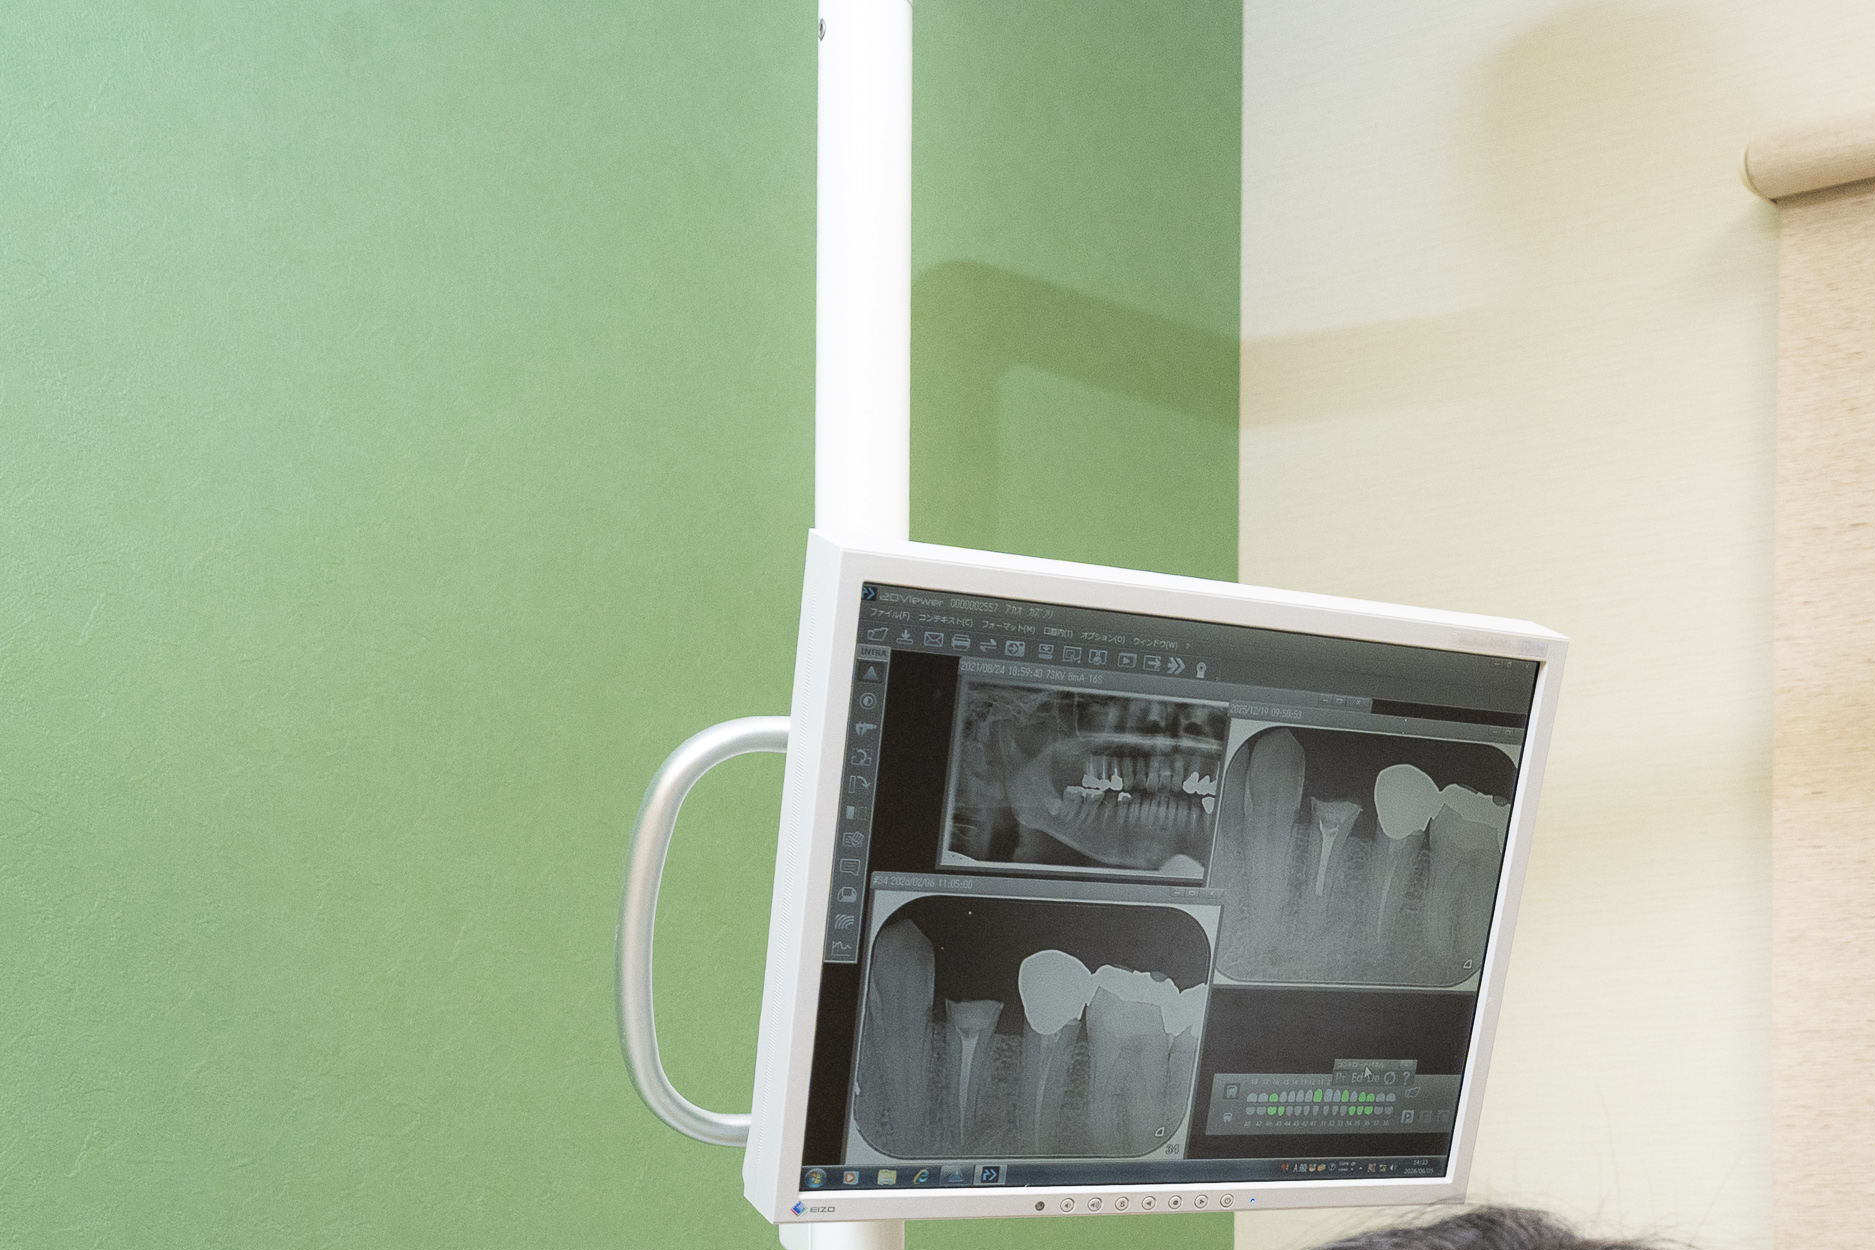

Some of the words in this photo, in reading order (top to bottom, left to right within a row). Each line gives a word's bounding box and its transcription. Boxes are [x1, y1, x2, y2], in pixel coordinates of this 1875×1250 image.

[870, 608, 910, 621] ファイル(F)
[919, 613, 973, 628] コンテキスト(C)
[861, 648, 887, 657] INTRA
[1165, 1144, 1180, 1154] 34
